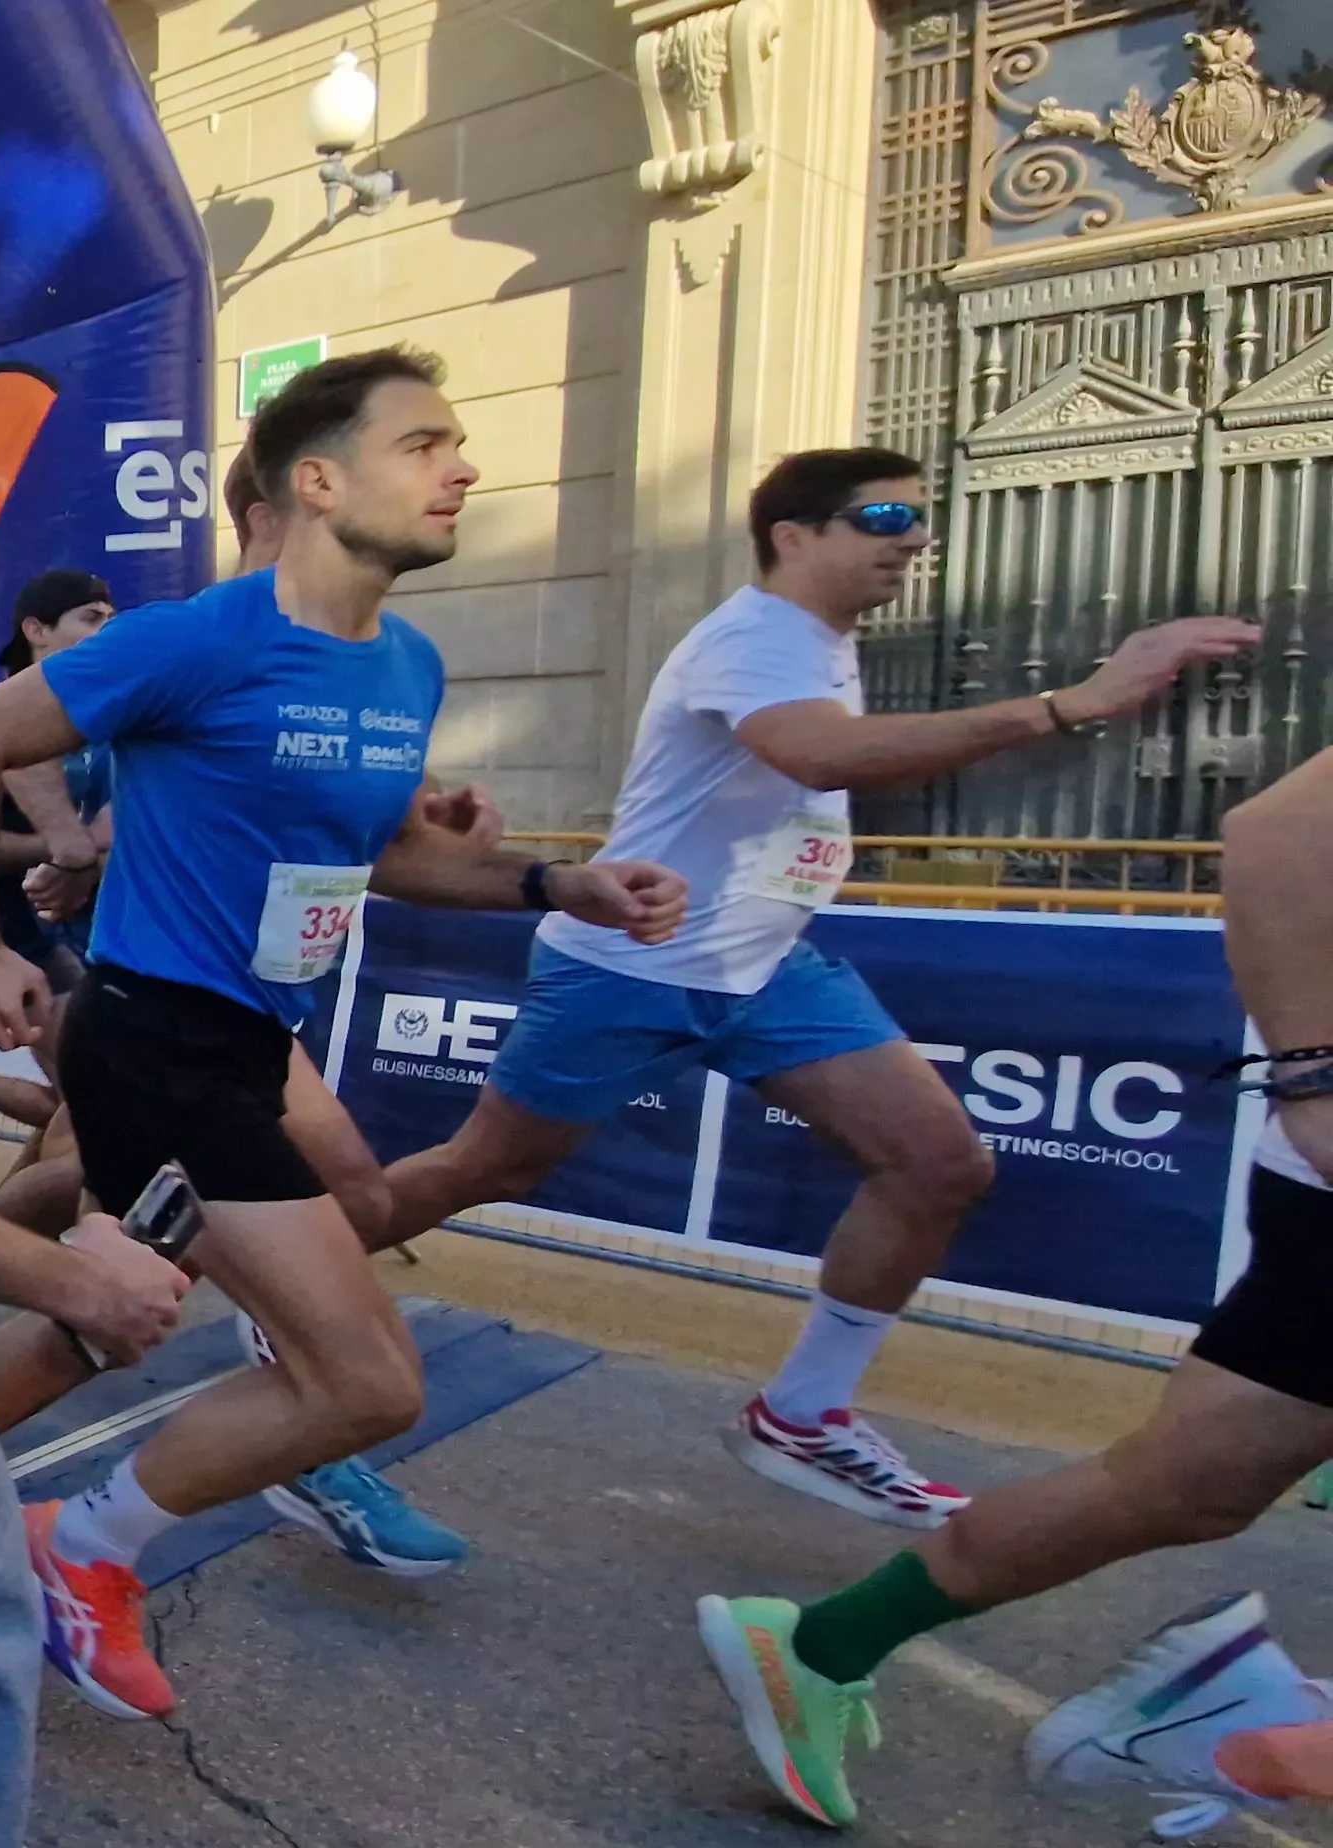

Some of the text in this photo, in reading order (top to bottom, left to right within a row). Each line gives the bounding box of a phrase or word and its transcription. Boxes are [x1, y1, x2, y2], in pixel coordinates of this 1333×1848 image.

[116, 449, 215, 521] es
[276, 731, 349, 758] NEXT
[909, 1042, 1185, 1140] SIC
[978, 1132, 1181, 1174] ETINGSCHOOL
